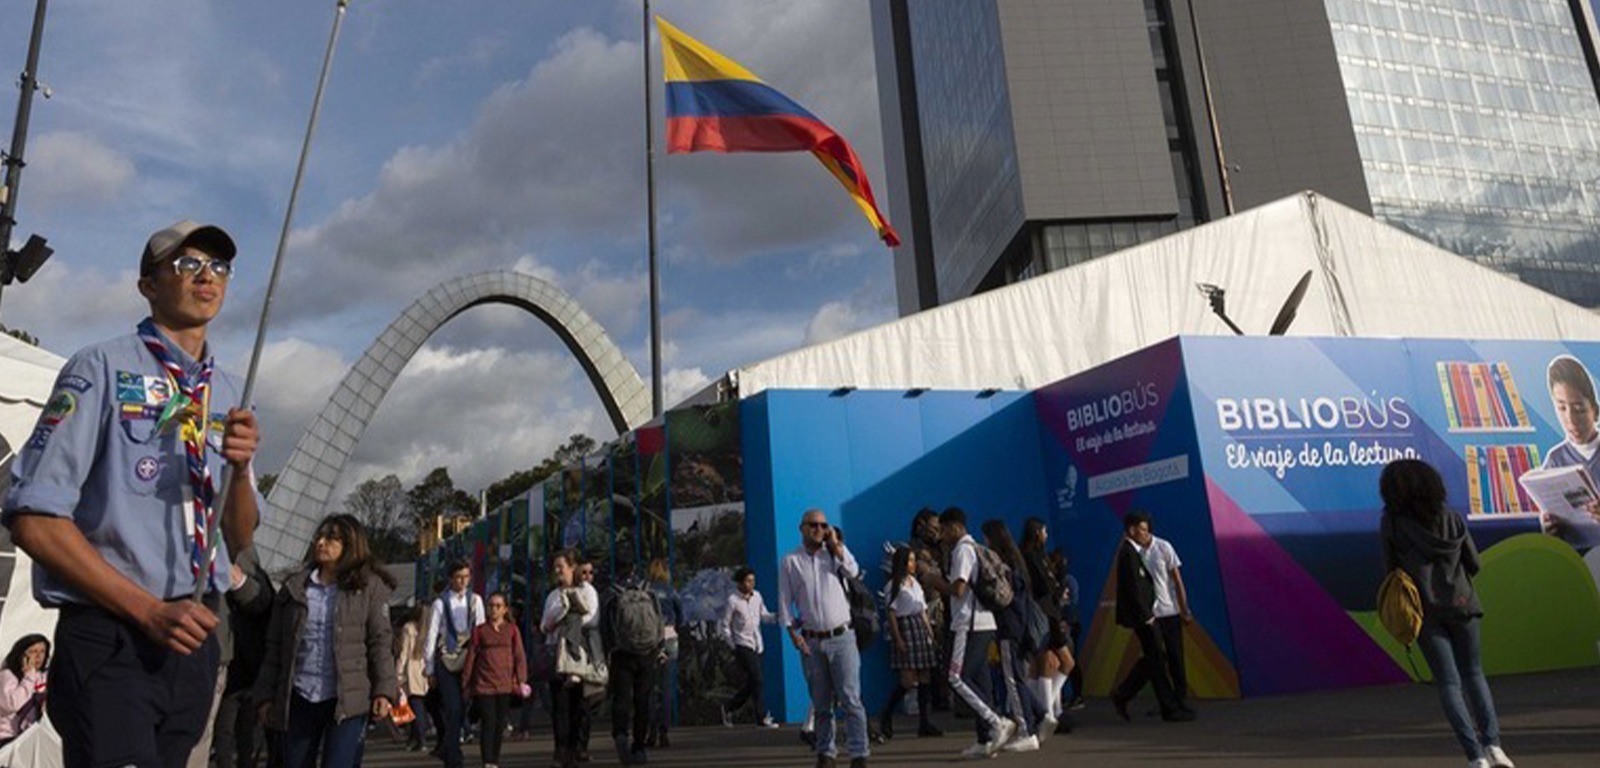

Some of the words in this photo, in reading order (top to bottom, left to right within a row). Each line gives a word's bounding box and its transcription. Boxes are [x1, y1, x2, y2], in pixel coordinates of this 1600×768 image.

[1066, 381, 1160, 431] BIBLIOBÚS
[1216, 390, 1412, 430] BIBLIOBÚS
[1225, 444, 1250, 468] El
[1251, 444, 1297, 479] viaje
[1298, 442, 1323, 466] de
[1324, 441, 1349, 467] la
